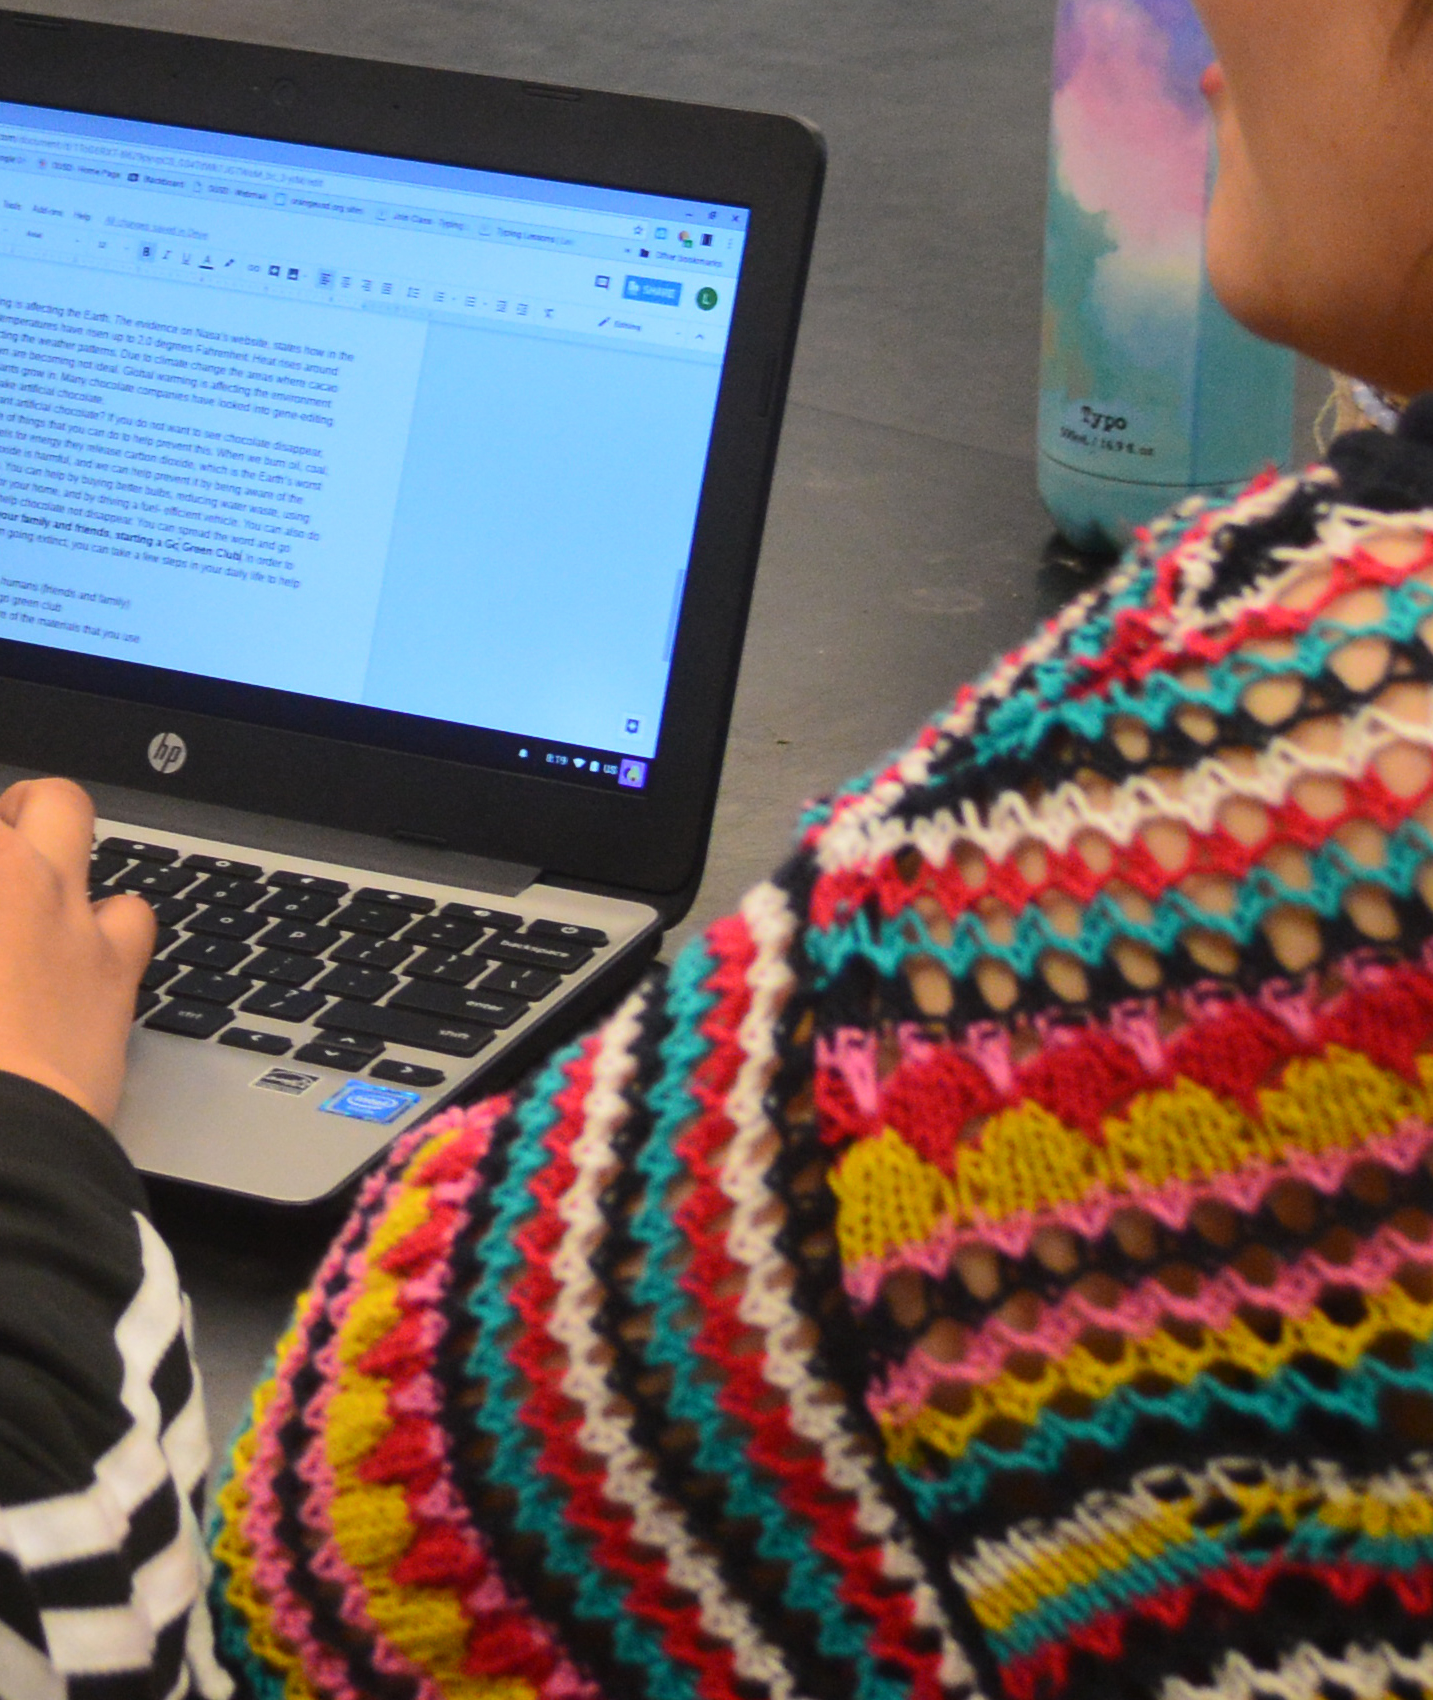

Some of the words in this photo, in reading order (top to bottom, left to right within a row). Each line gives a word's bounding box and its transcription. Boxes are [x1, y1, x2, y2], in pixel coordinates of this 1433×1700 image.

[642, 284, 675, 299] SHARE
[701, 293, 710, 305] L
[23, 300, 65, 319] affecting
[65, 306, 83, 319] the
[112, 314, 133, 327] The
[134, 319, 179, 334] evidence
[179, 326, 194, 336] on
[271, 340, 303, 354] states
[302, 343, 326, 357] how
[337, 349, 356, 362] the
[59, 321, 84, 336] have
[84, 326, 110, 340] risen
[110, 332, 125, 344] up
[124, 333, 136, 344] to
[153, 336, 194, 353] degrees
[251, 352, 277, 366] Heat
[277, 356, 303, 370] rises
[302, 362, 339, 376] around
[19, 332, 37, 344] the
[36, 336, 76, 351] weather
[119, 348, 141, 361] Due
[141, 352, 153, 363] to
[153, 354, 189, 369] climate
[189, 359, 227, 376] change
[227, 365, 245, 378] the
[244, 370, 274, 382] areas
[274, 373, 307, 388] where
[307, 380, 339, 393] cacao
[9, 348, 28, 359] are
[28, 349, 76, 369] becoming
[76, 359, 94, 370] not
[121, 365, 155, 380] Global
[155, 372, 198, 389] warming
[208, 379, 252, 398] affecting
[252, 386, 270, 398] the
[269, 390, 332, 408] environment
[1080, 405, 1128, 432] Typo
[19, 512, 52, 530] family
[51, 520, 73, 532] and
[113, 530, 154, 548] starting
[180, 541, 214, 556] Green
[254, 555, 282, 568] order
[281, 558, 293, 570] to
[0, 575, 39, 592] humans
[76, 591, 98, 602] and
[10, 595, 40, 609] green
[40, 599, 63, 613] club
[7, 610, 20, 621] of
[19, 612, 36, 624] the
[35, 616, 81, 633] materials
[81, 623, 102, 636] that
[100, 628, 121, 640] you
[121, 632, 141, 644] use
[151, 732, 184, 773] hp
[545, 753, 569, 765] 8:19
[603, 763, 618, 775] US
[500, 939, 570, 958] backspace
[466, 1000, 504, 1012] enter
